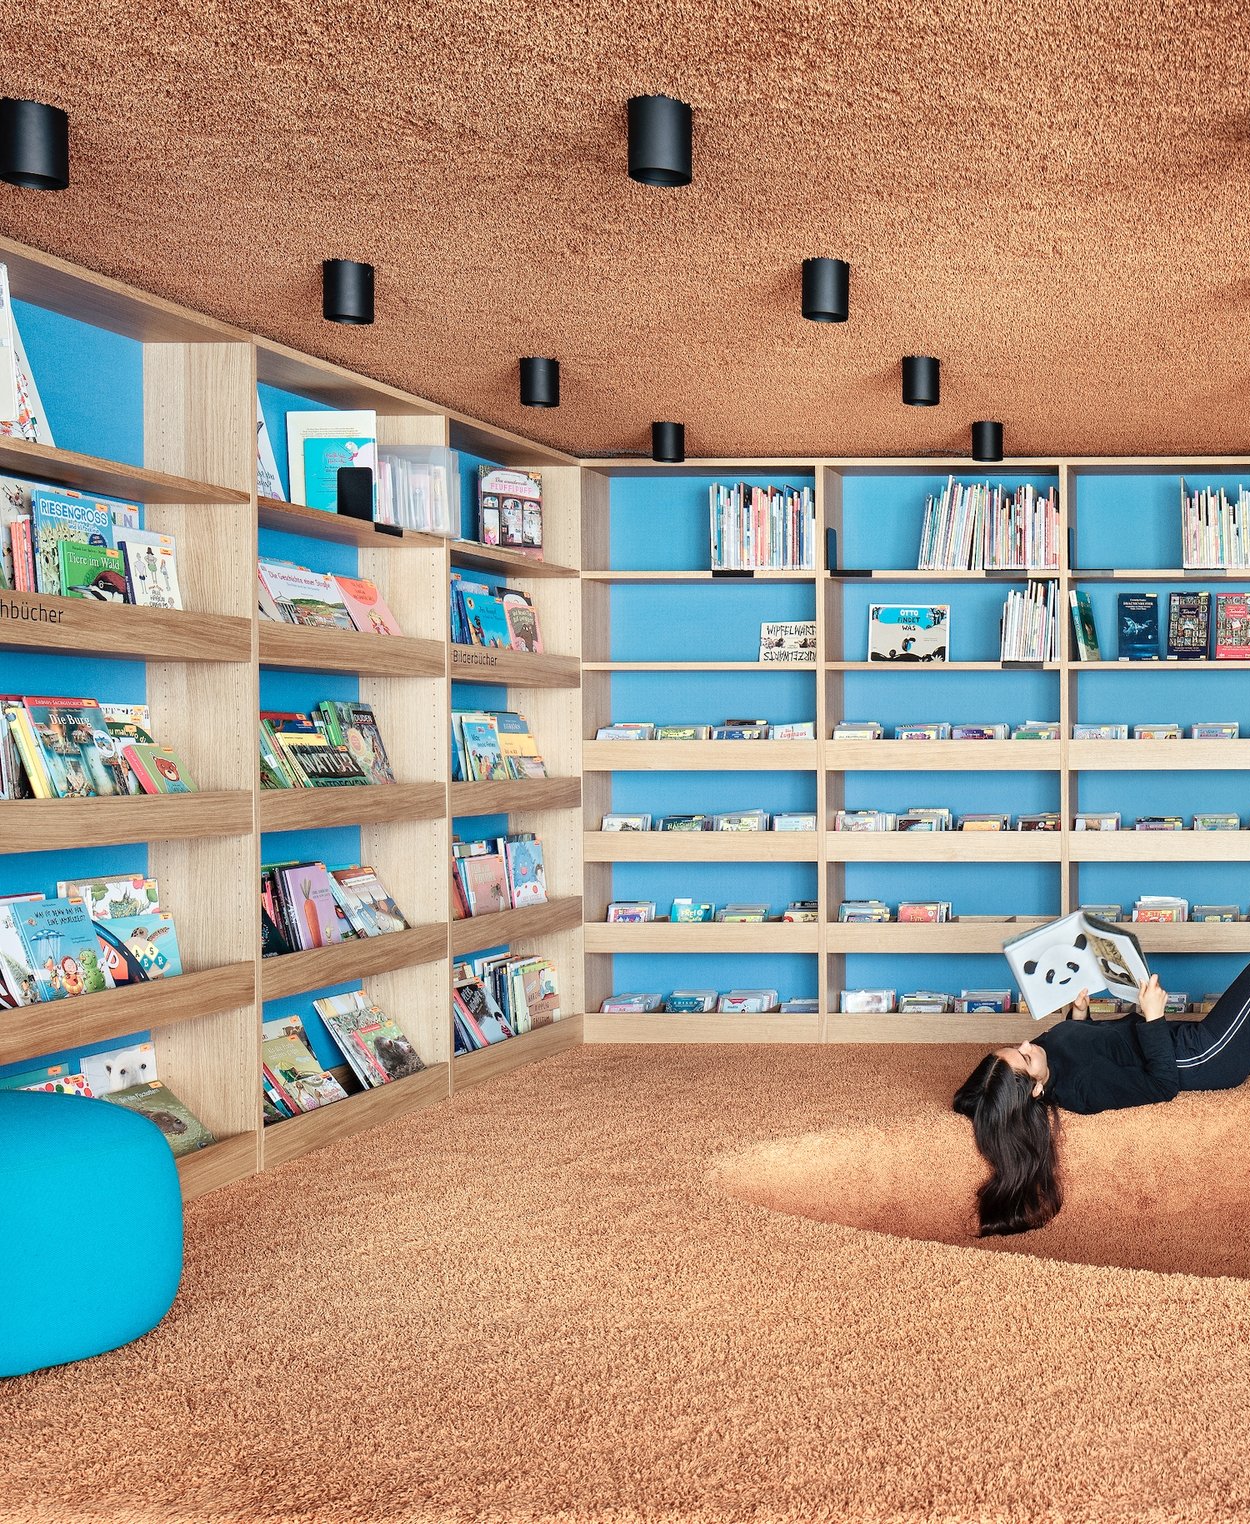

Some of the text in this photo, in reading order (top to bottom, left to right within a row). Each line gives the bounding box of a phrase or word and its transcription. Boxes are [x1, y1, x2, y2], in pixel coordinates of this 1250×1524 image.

[40, 500, 108, 526] RIESENGROSS
[67, 552, 120, 570] Tiere im Wald
[766, 624, 816, 636] WIPFELWÄRT
[453, 650, 498, 666] Bilderbücher
[48, 713, 92, 728] Die Burg
[300, 752, 359, 774] NATUR
[34, 911, 44, 919] WAS
[52, 908, 65, 917] DENN
[47, 918, 59, 926] EINE
